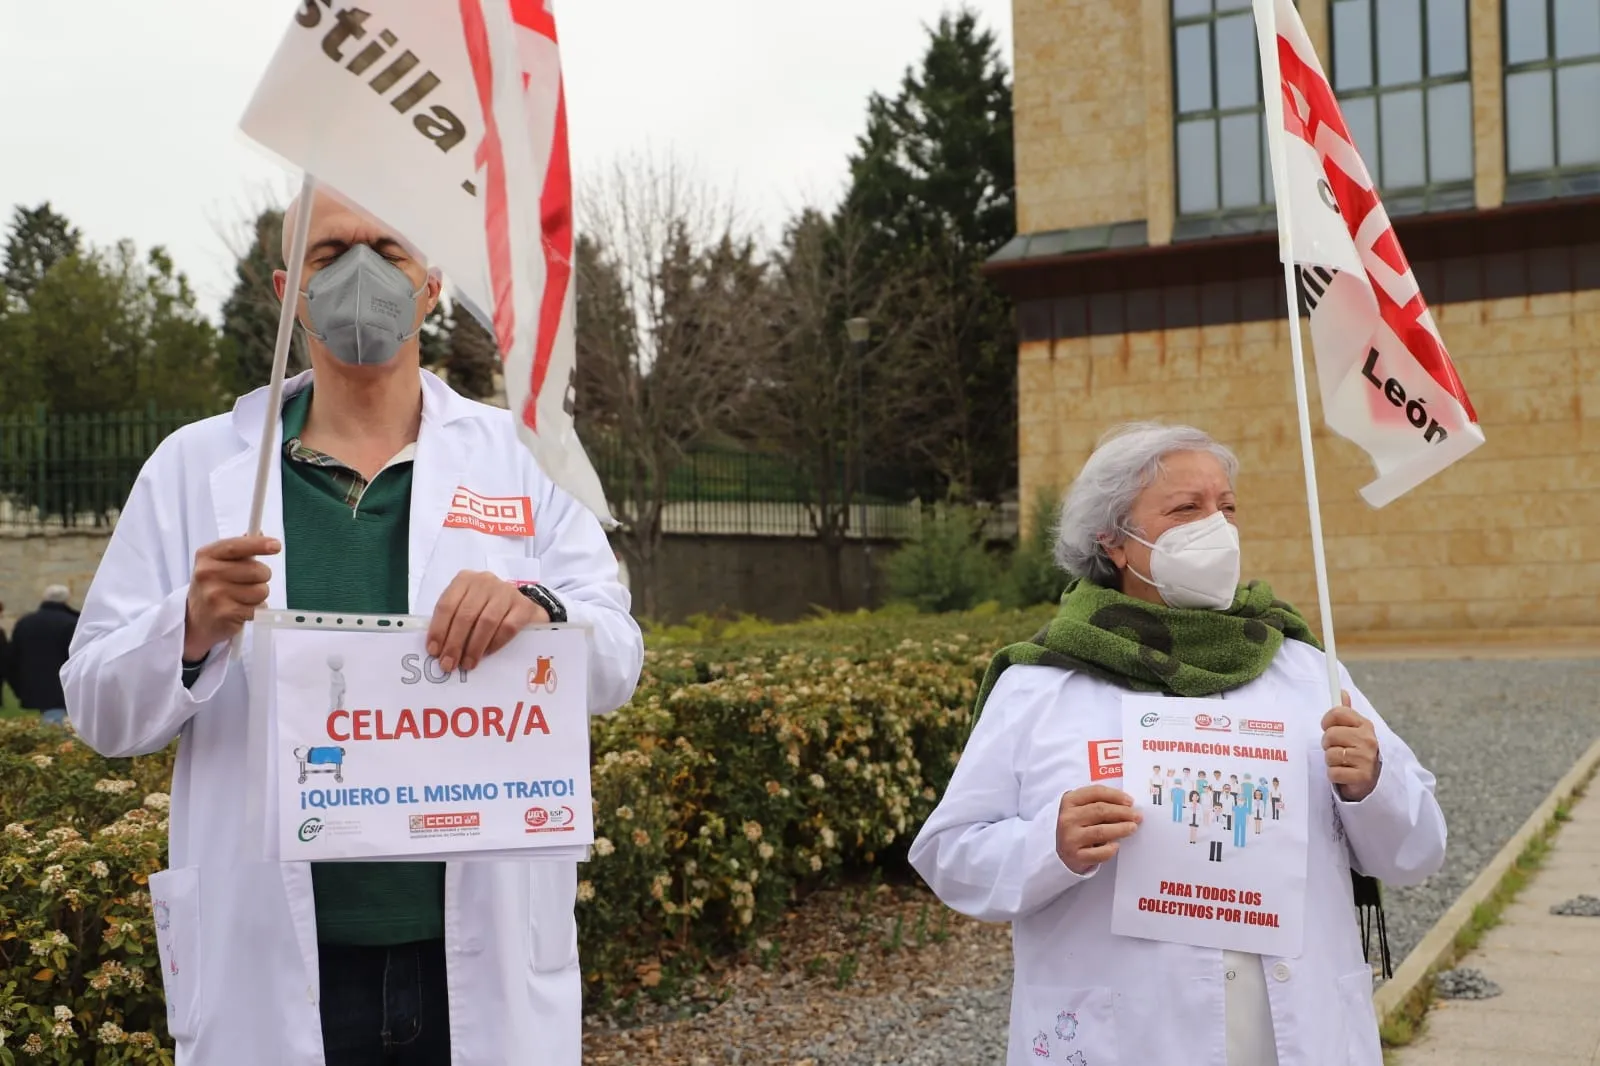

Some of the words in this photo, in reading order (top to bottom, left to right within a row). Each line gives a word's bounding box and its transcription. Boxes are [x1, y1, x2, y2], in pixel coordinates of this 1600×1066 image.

[1361, 346, 1448, 446] León
[452, 493, 517, 519] CCOO
[446, 514, 486, 529] Castilla
[489, 524, 495, 533] y
[498, 524, 527, 533] León
[327, 702, 550, 743] CELADOR/A
[1142, 739, 1231, 757] EQUIPARACIÓN
[1233, 745, 1289, 762] SALARIAL
[301, 787, 390, 810] ¡QUIERO
[396, 785, 419, 804] EL
[424, 782, 498, 803] MISMO
[503, 778, 575, 799] TRATO!
[303, 824, 325, 834] CSIF
[426, 815, 463, 826] CCOO
[1160, 880, 1192, 898] PARA
[1195, 885, 1236, 903] TODOS
[1238, 890, 1262, 906] LOS
[1138, 897, 1214, 920] COLECTIVOS
[1216, 907, 1242, 923] POR
[1244, 910, 1280, 928] IGUAL
